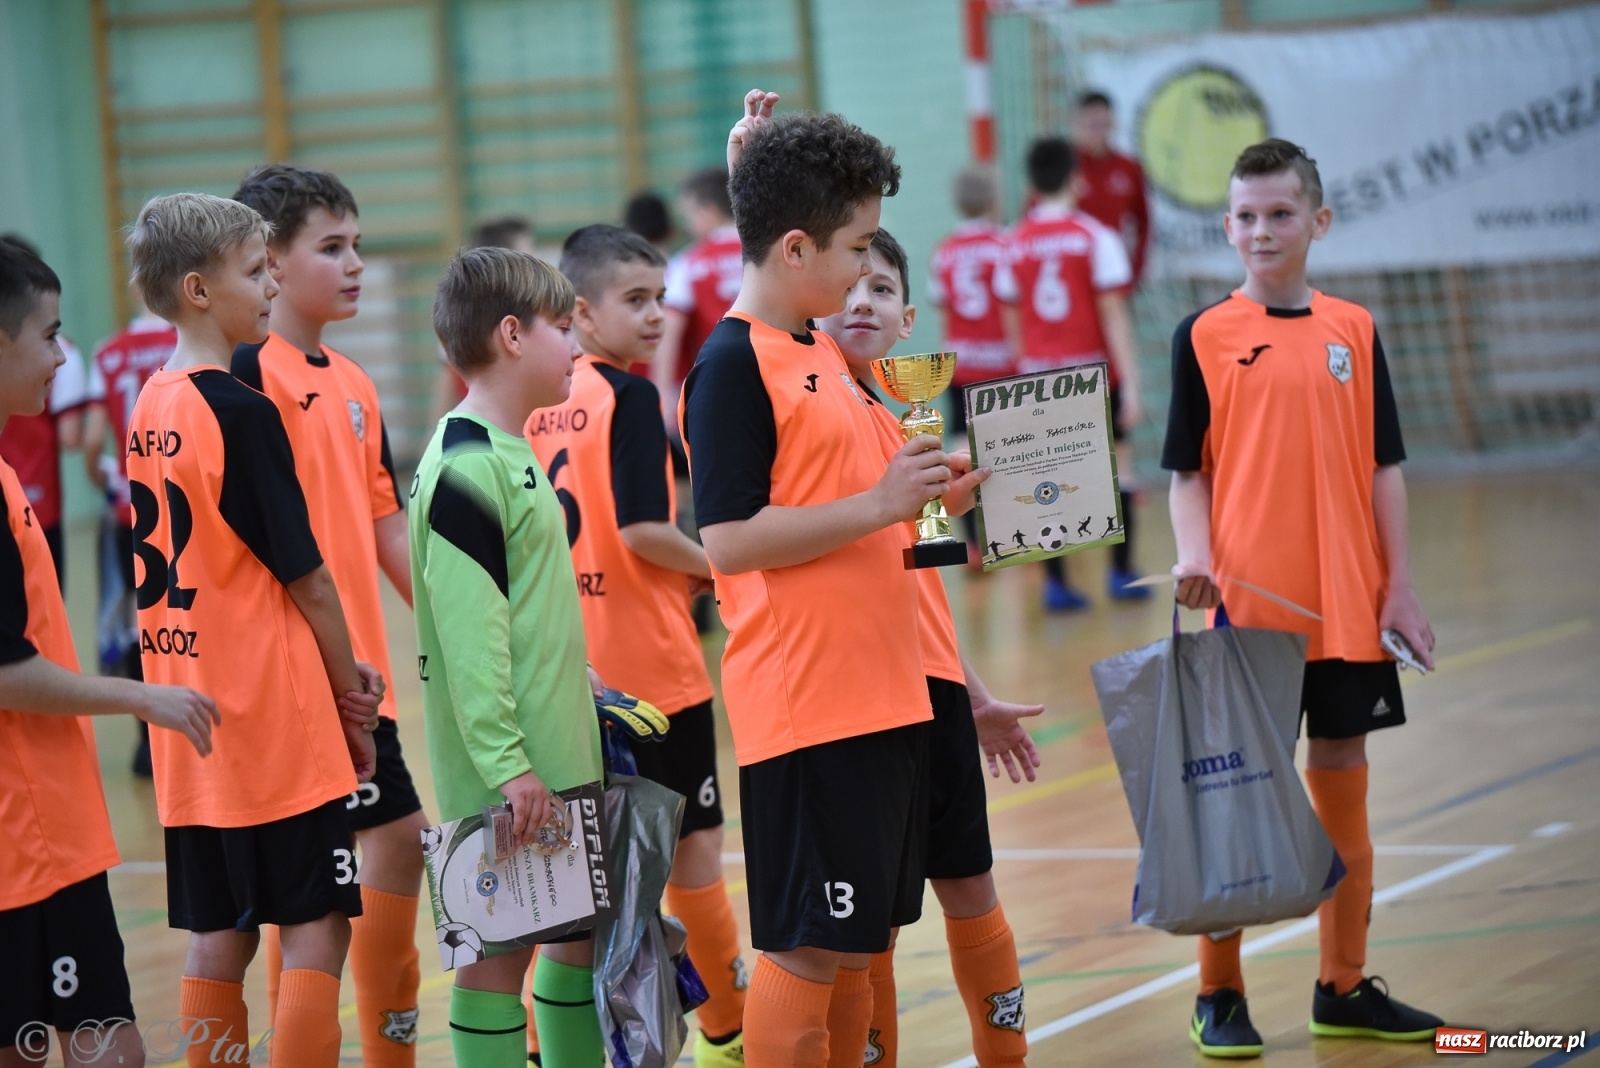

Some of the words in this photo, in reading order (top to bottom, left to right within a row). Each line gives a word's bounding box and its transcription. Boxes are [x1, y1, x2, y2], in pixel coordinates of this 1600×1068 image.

[975, 369, 1099, 416] DYPLOM
[1032, 408, 1045, 417] dla
[993, 456, 1008, 466] Za
[1010, 449, 1045, 463] zajęcie
[1054, 440, 1092, 454] miejsca
[698, 775, 716, 809] 6
[566, 854, 574, 867] dla
[581, 798, 611, 909] DYPLOM
[527, 872, 542, 925] BRAMKARZ
[52, 956, 79, 998] 8
